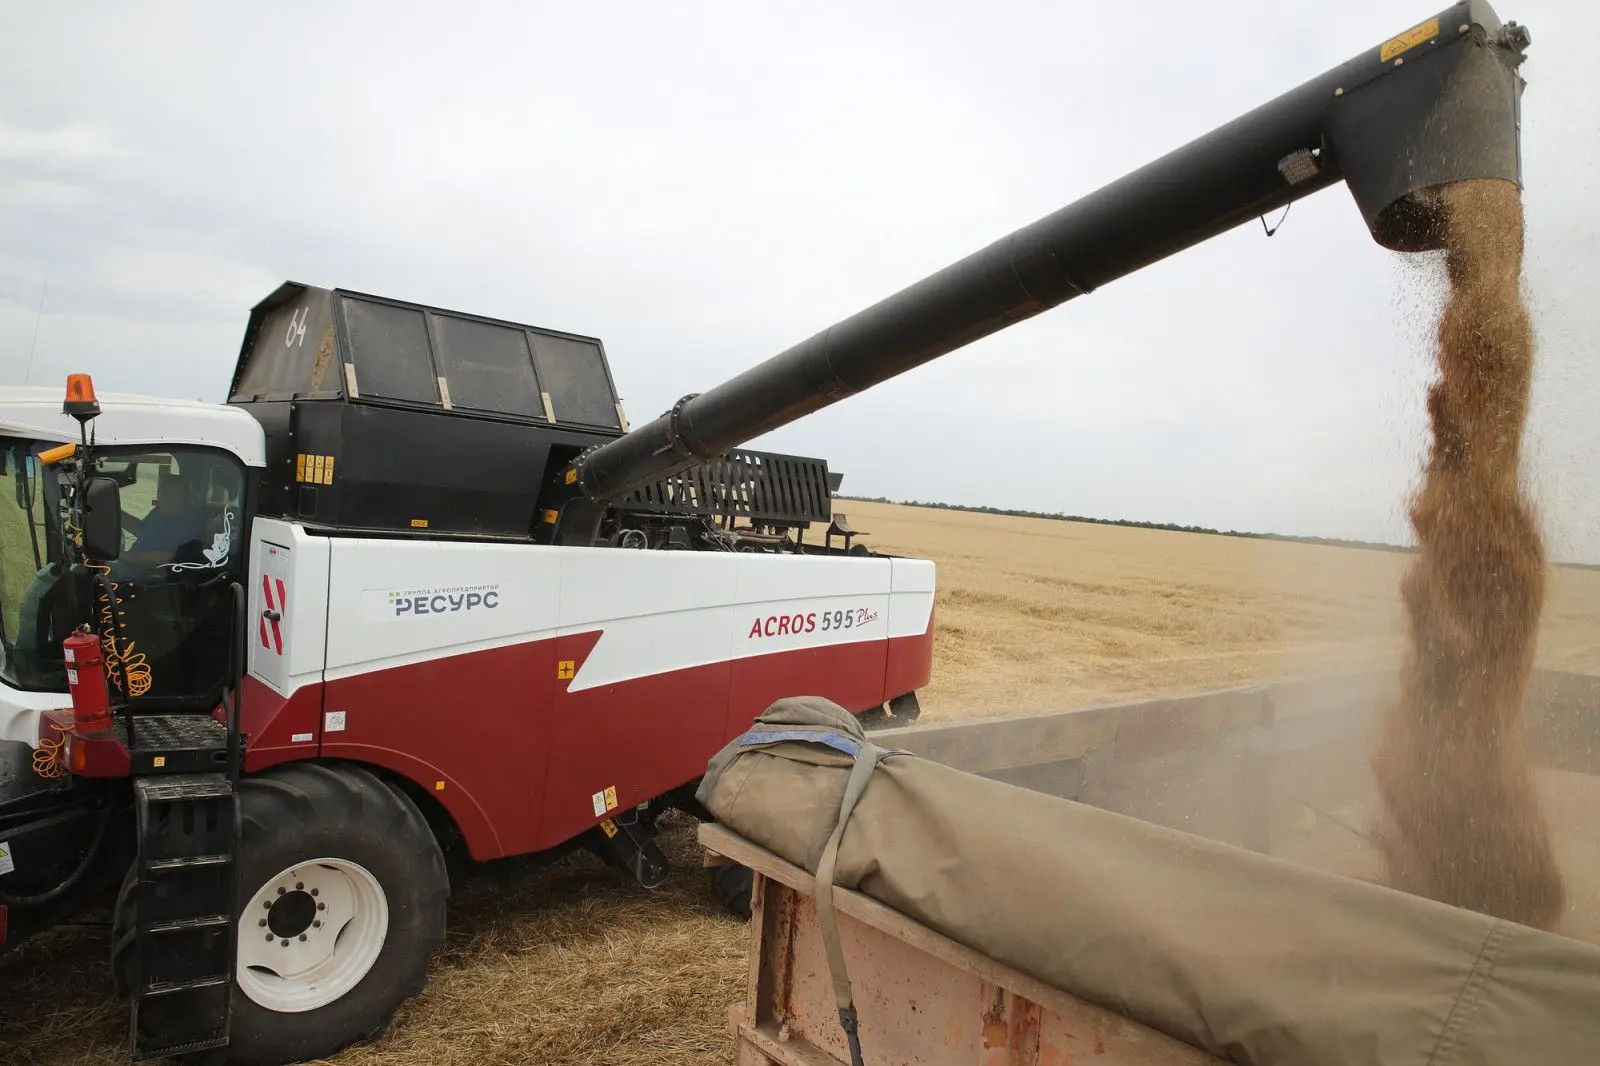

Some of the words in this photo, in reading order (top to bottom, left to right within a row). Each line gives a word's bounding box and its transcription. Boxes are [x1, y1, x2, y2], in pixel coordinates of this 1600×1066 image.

[285, 306, 309, 348] 64
[395, 591, 499, 616] РЕСУРС
[404, 589, 431, 597] ГРУППА
[434, 584, 499, 593] АГРОПРЕДПРИЯТИЙ
[748, 612, 817, 639] ACROS
[821, 609, 854, 632] 595
[855, 607, 878, 624] Plus
